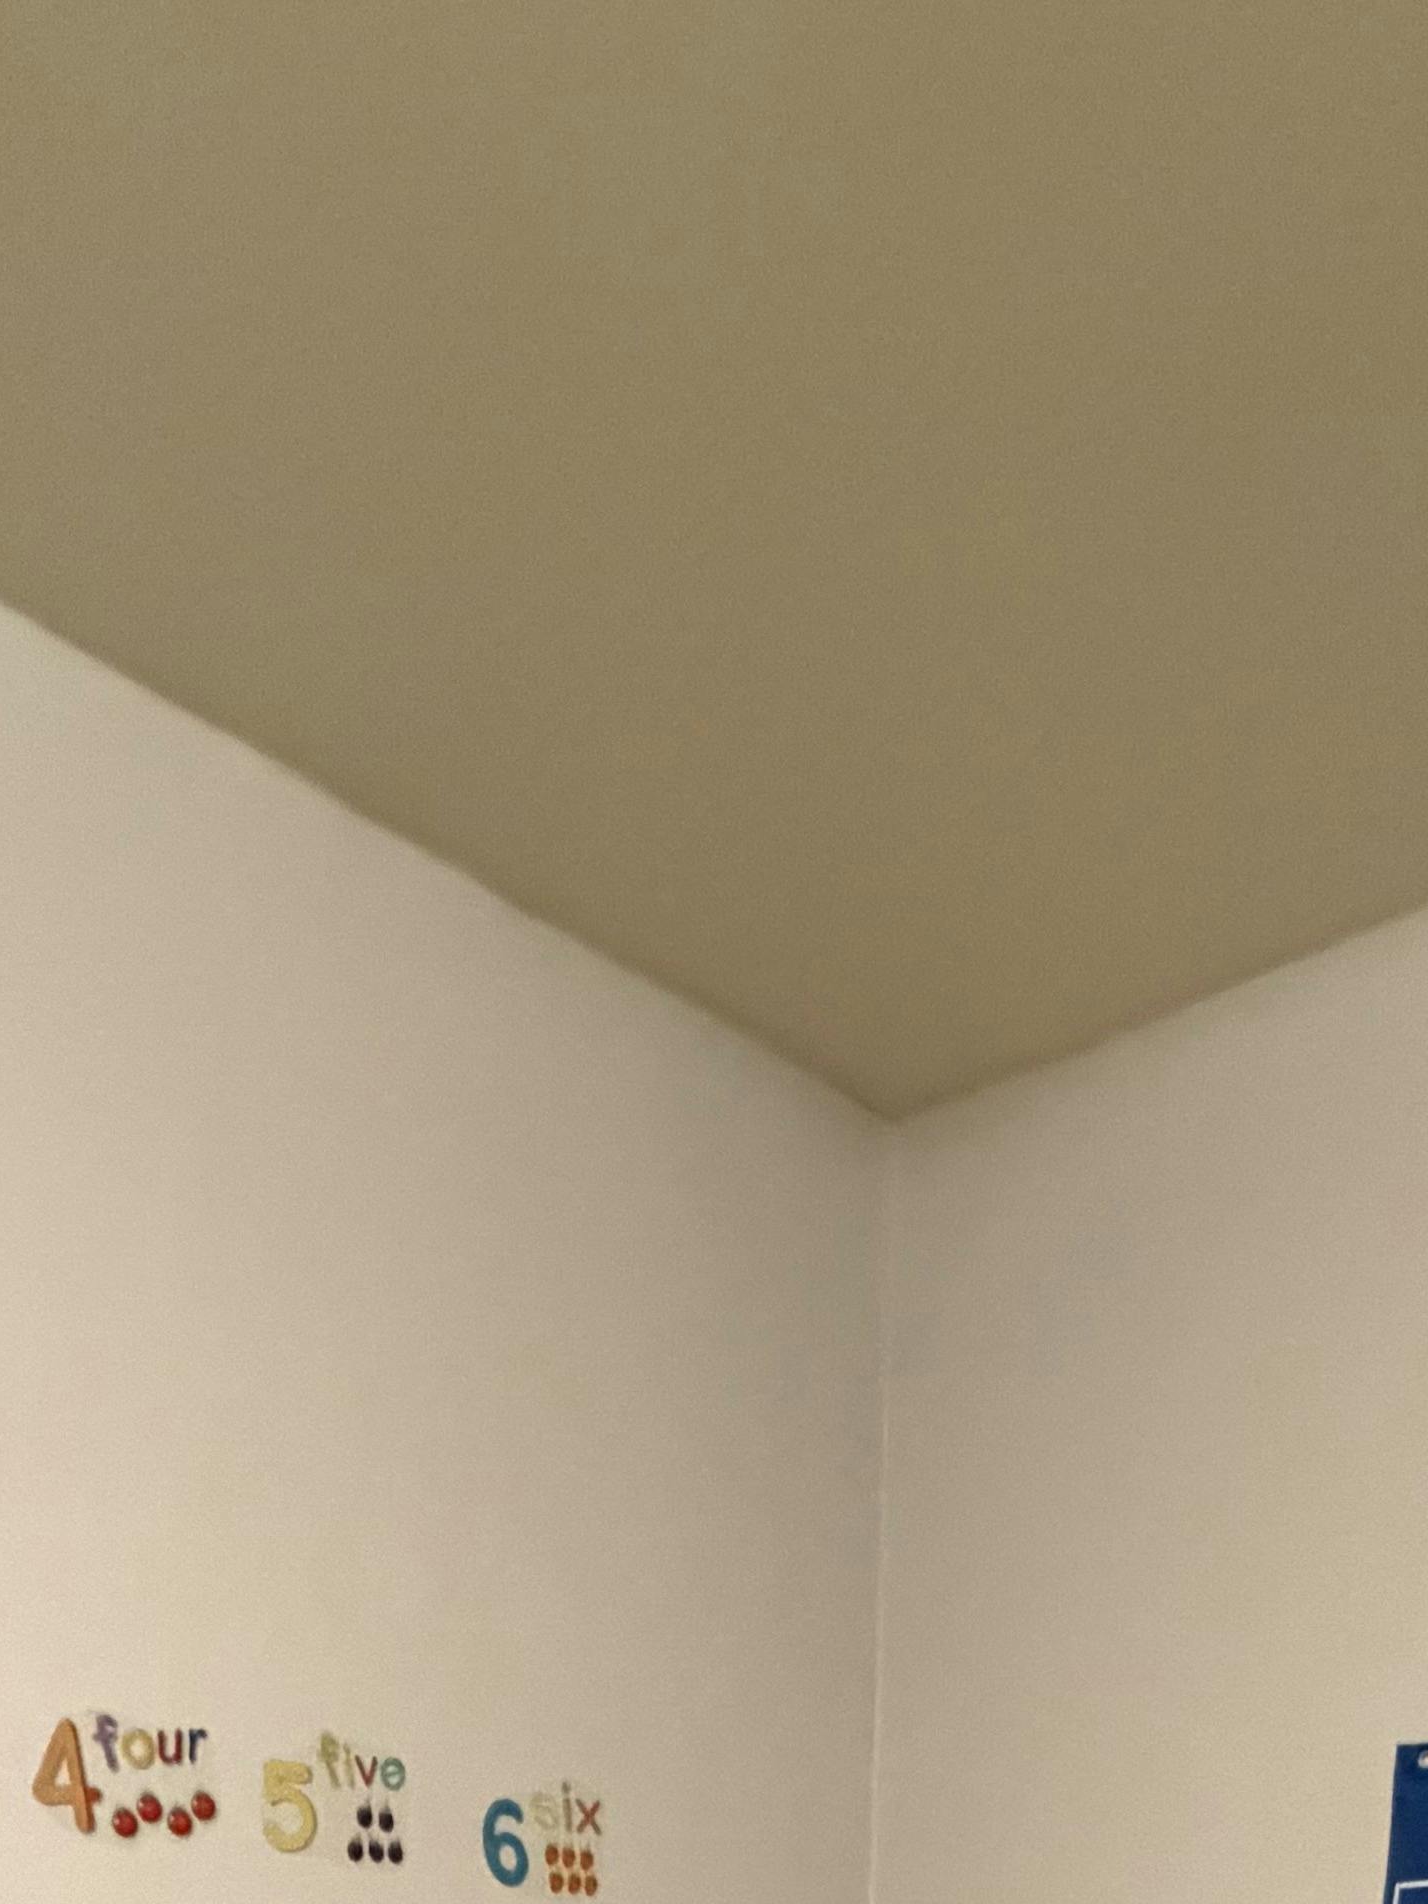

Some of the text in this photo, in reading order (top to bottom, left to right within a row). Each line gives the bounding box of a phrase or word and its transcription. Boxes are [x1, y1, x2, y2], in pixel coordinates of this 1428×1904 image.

[32, 1714, 209, 1834] 4 four
[262, 1731, 406, 1852] 5 five
[482, 1781, 602, 1887] 6 six
